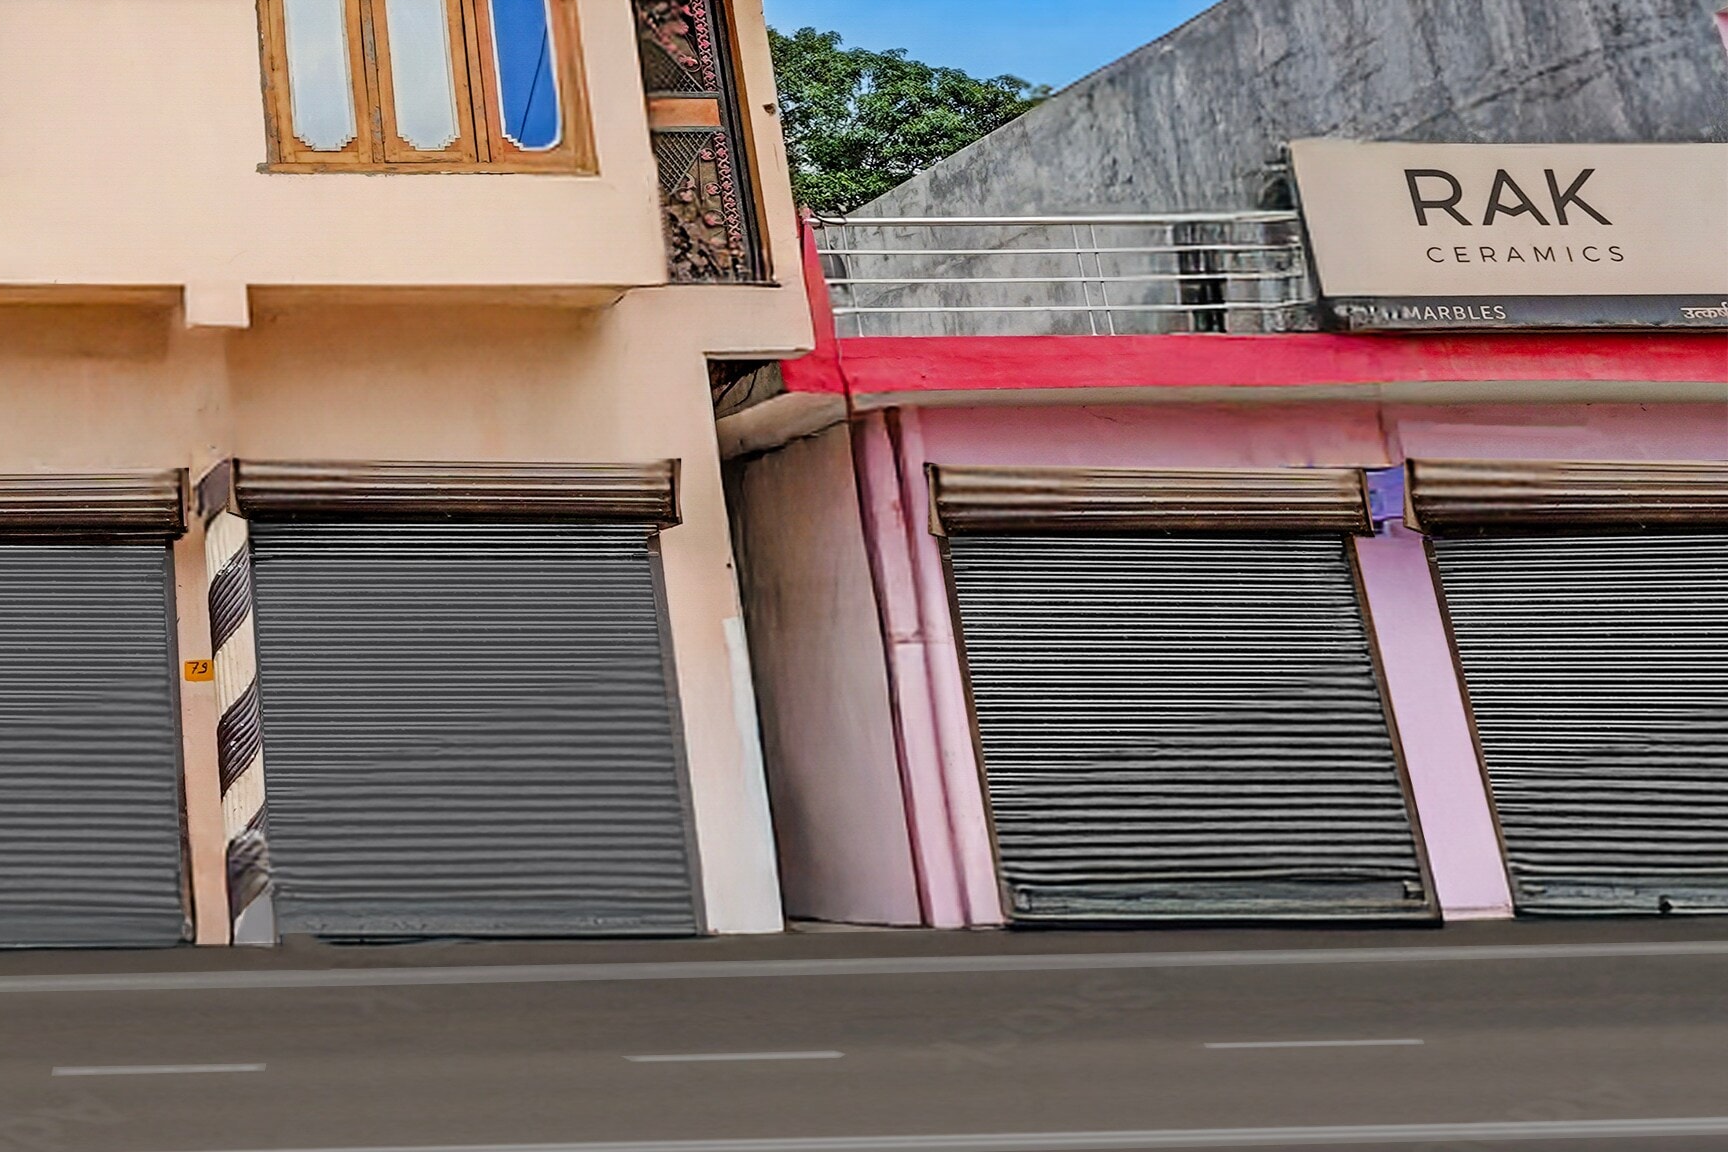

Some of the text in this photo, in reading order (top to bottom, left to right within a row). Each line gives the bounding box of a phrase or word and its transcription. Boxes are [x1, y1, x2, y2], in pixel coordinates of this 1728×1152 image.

[1404, 168, 1613, 227] RAK
[1426, 245, 1624, 263] CERAMICS
[1403, 305, 1507, 321] MARBLES
